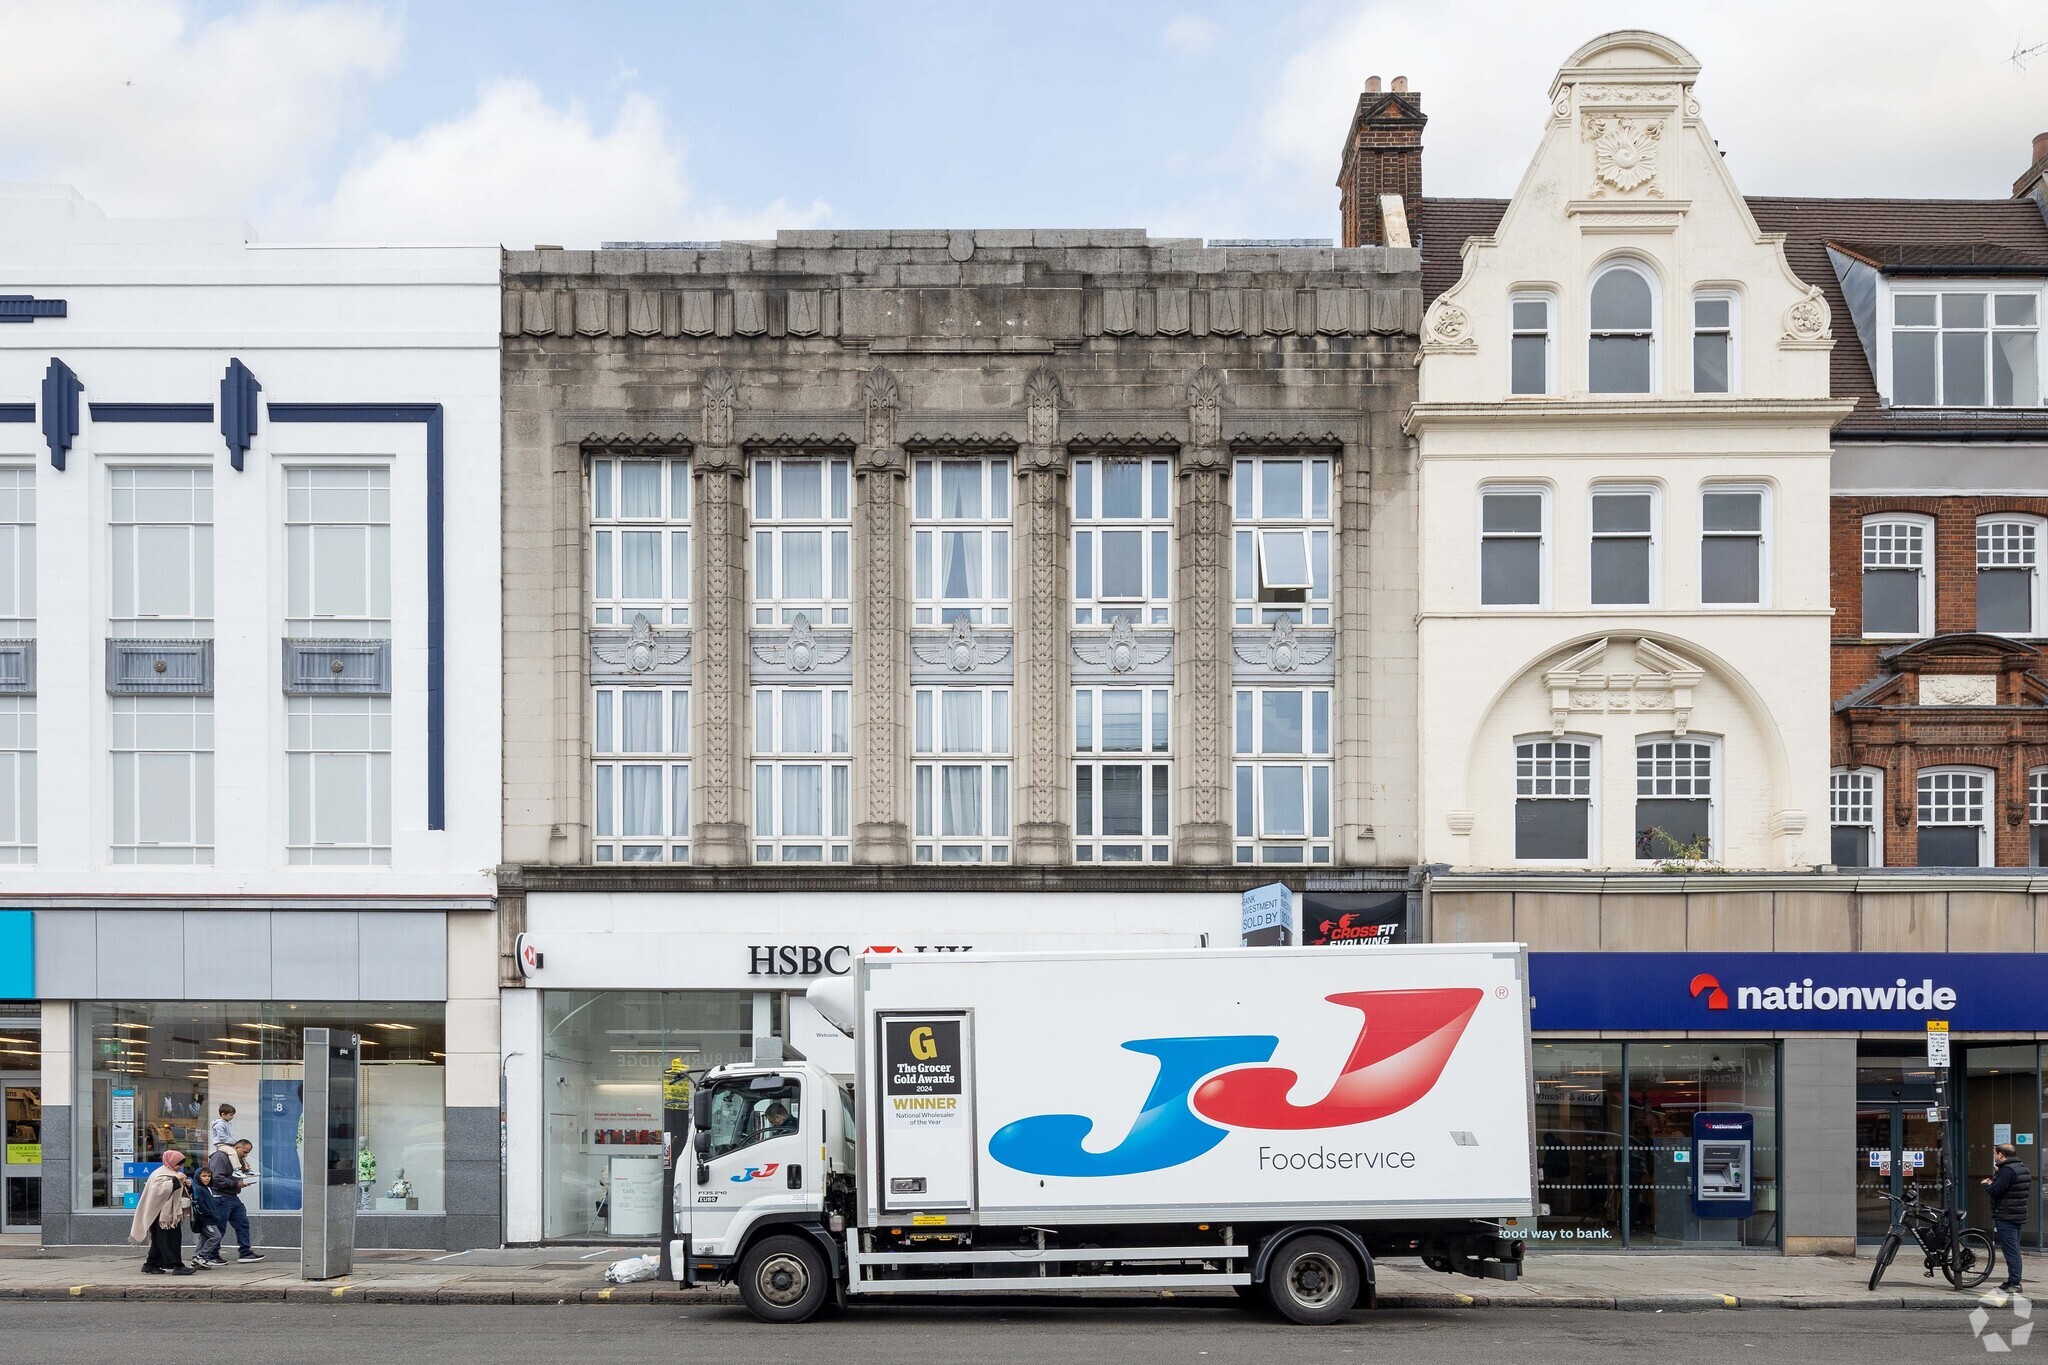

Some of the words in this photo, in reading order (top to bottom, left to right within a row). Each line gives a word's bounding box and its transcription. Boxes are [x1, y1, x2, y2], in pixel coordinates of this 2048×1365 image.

[1243, 915, 1264, 930] SOLD
[1265, 911, 1278, 925] BY
[1331, 923, 1399, 940] CROSSFIT
[747, 945, 851, 976] HSBC
[1737, 978, 1957, 1011] nationwide
[909, 1026, 938, 1061] G
[896, 1063, 917, 1073] The
[918, 1063, 952, 1073] Grocer
[893, 1074, 917, 1084] Gold
[917, 1073, 955, 1084] Awards
[893, 1097, 957, 1110] WINNER
[1258, 1146, 1416, 1171] Foodservice
[1531, 1229, 1557, 1241] way
[1560, 1228, 1574, 1239] to
[1576, 1227, 1613, 1239] bank.
